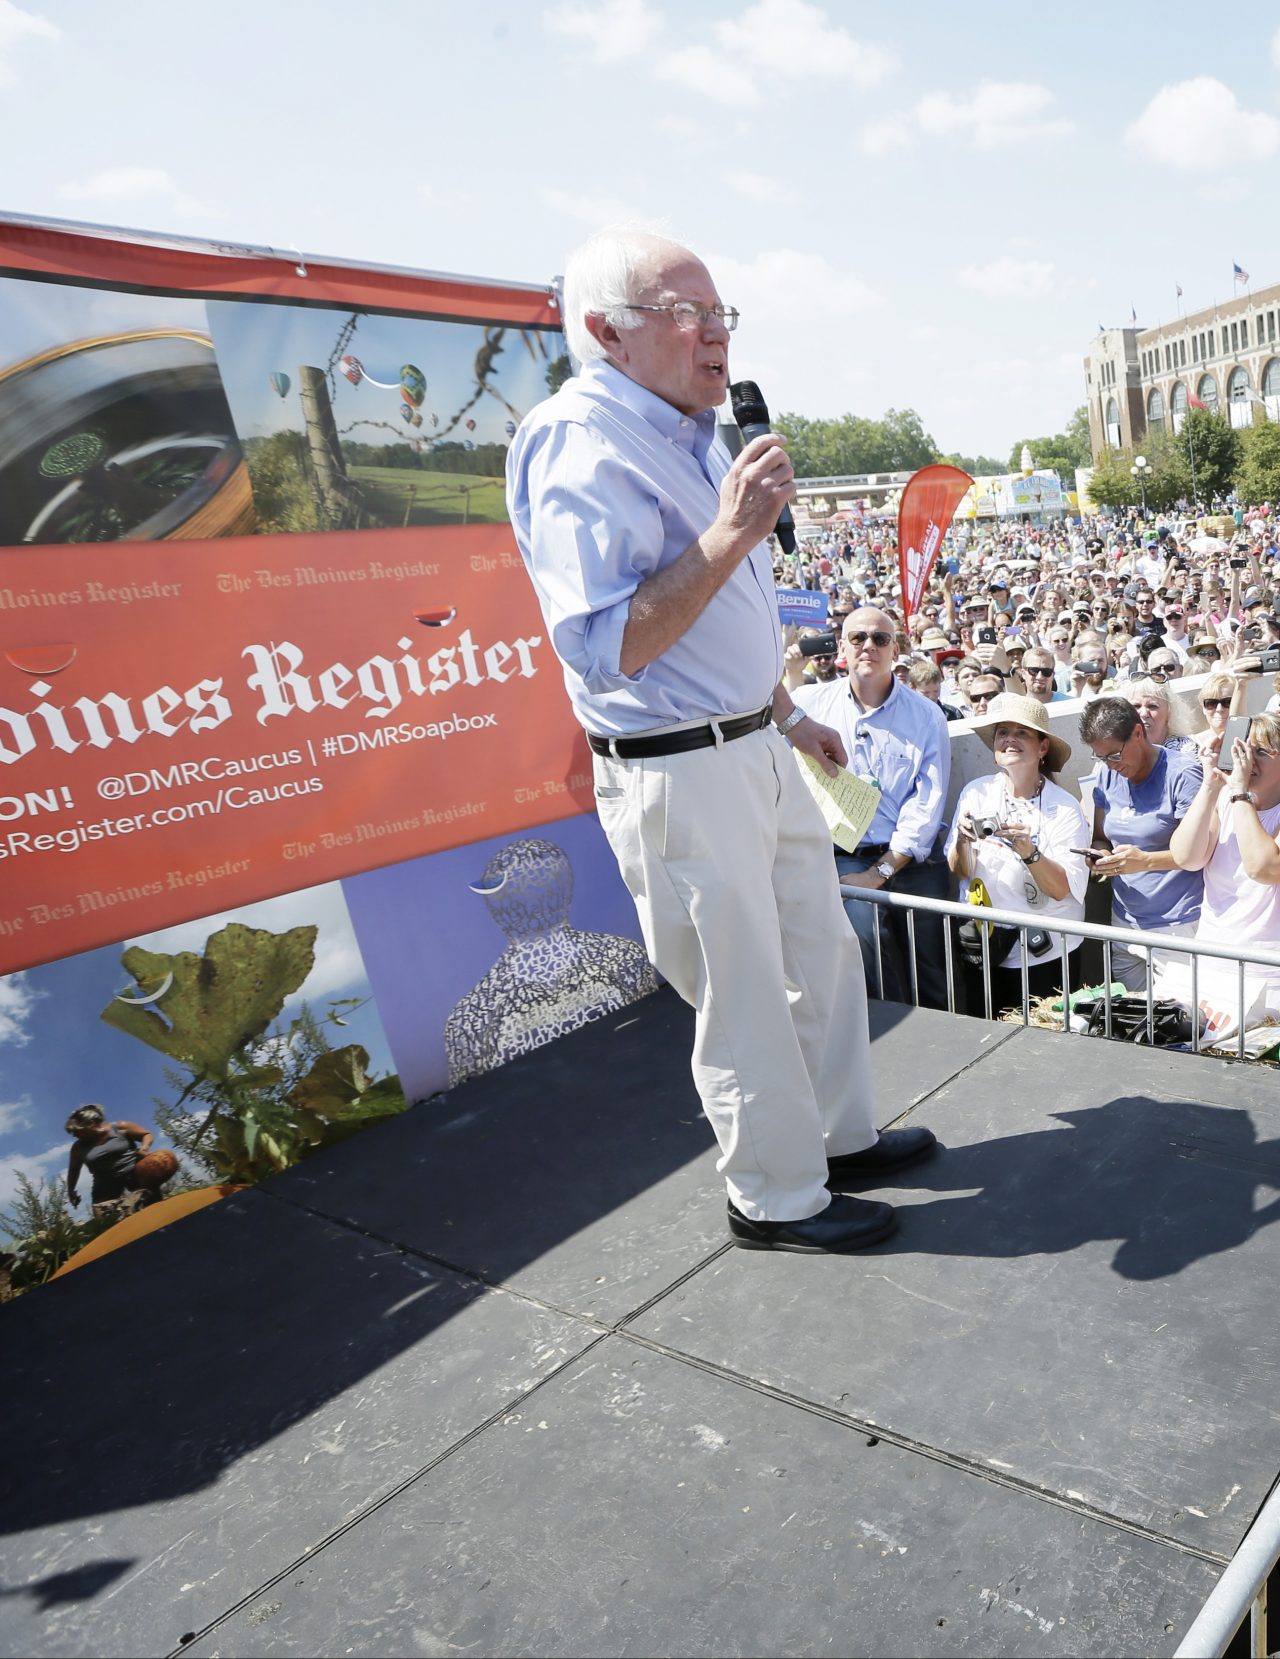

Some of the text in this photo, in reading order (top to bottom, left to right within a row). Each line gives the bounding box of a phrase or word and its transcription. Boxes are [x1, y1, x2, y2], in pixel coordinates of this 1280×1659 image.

[216, 561, 440, 593] The Des Moines Register
[469, 554, 497, 572] The
[86, 582, 182, 604] Register
[777, 593, 822, 608] Bernie
[241, 629, 542, 727] Register
[97, 748, 302, 800] @DMRCaucus
[321, 711, 498, 759] #DMRSoapbox
[513, 788, 541, 804] The
[543, 778, 568, 796] Des
[282, 801, 488, 860] The Des Moines Register
[27, 903, 75, 926] Des
[76, 880, 164, 916] Moines
[166, 858, 250, 893] Register
